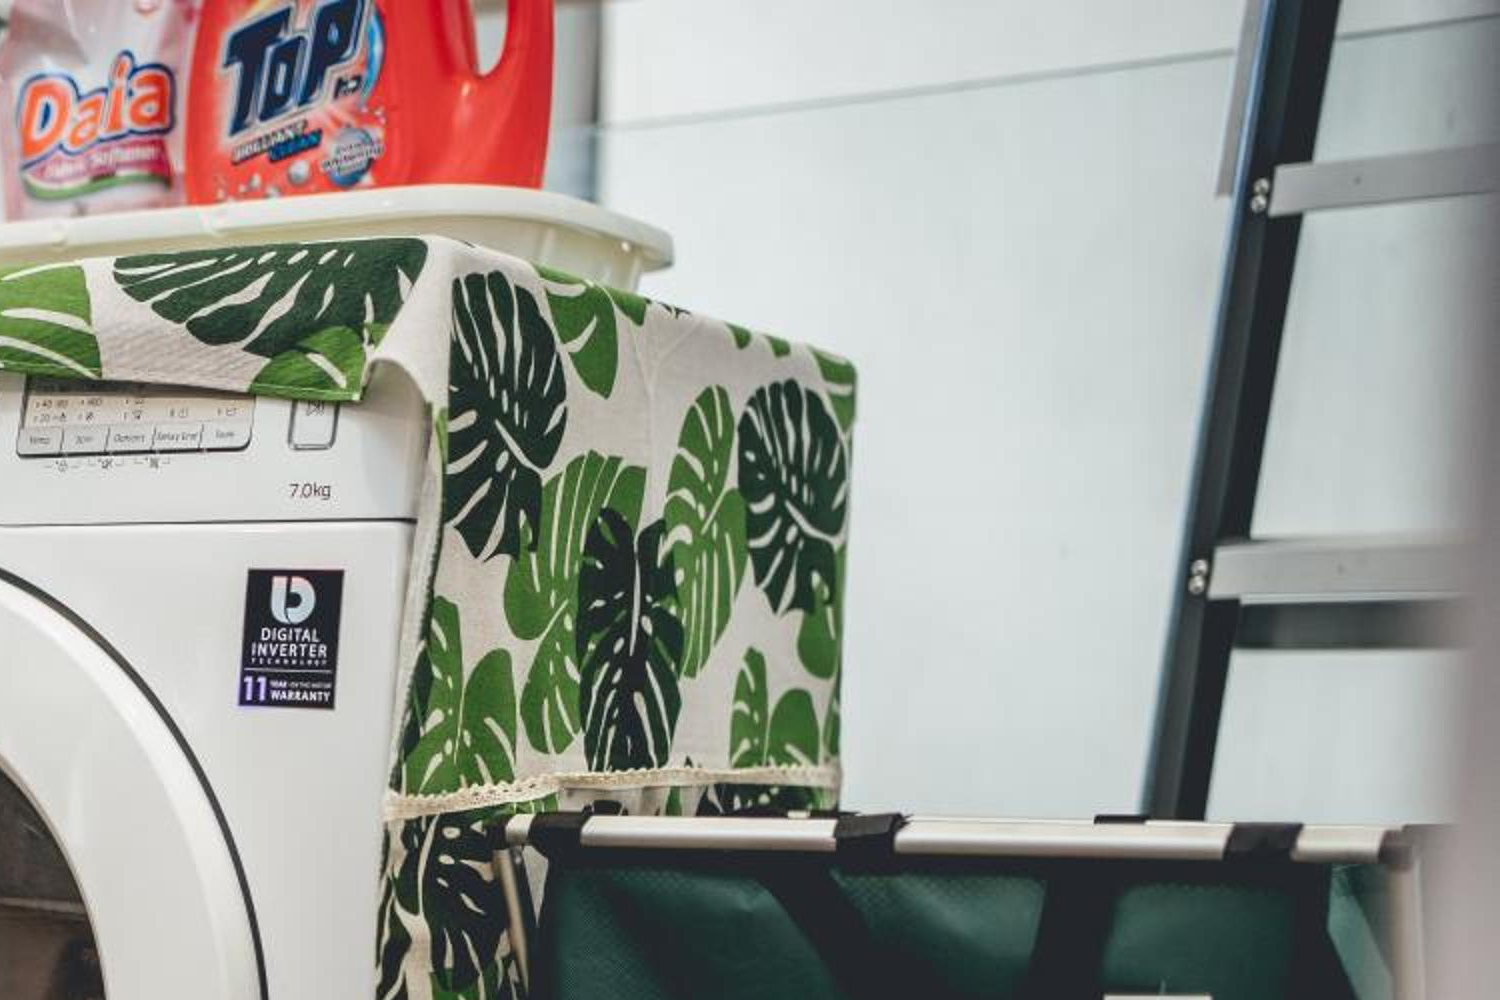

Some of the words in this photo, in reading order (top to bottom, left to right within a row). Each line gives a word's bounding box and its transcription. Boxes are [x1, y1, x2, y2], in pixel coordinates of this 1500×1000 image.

[18, 52, 174, 158] Daia
[260, 627, 320, 643] DIGITAL
[251, 642, 328, 658] INVERTER
[243, 675, 268, 701] 11
[269, 690, 332, 702] WARRANTY
